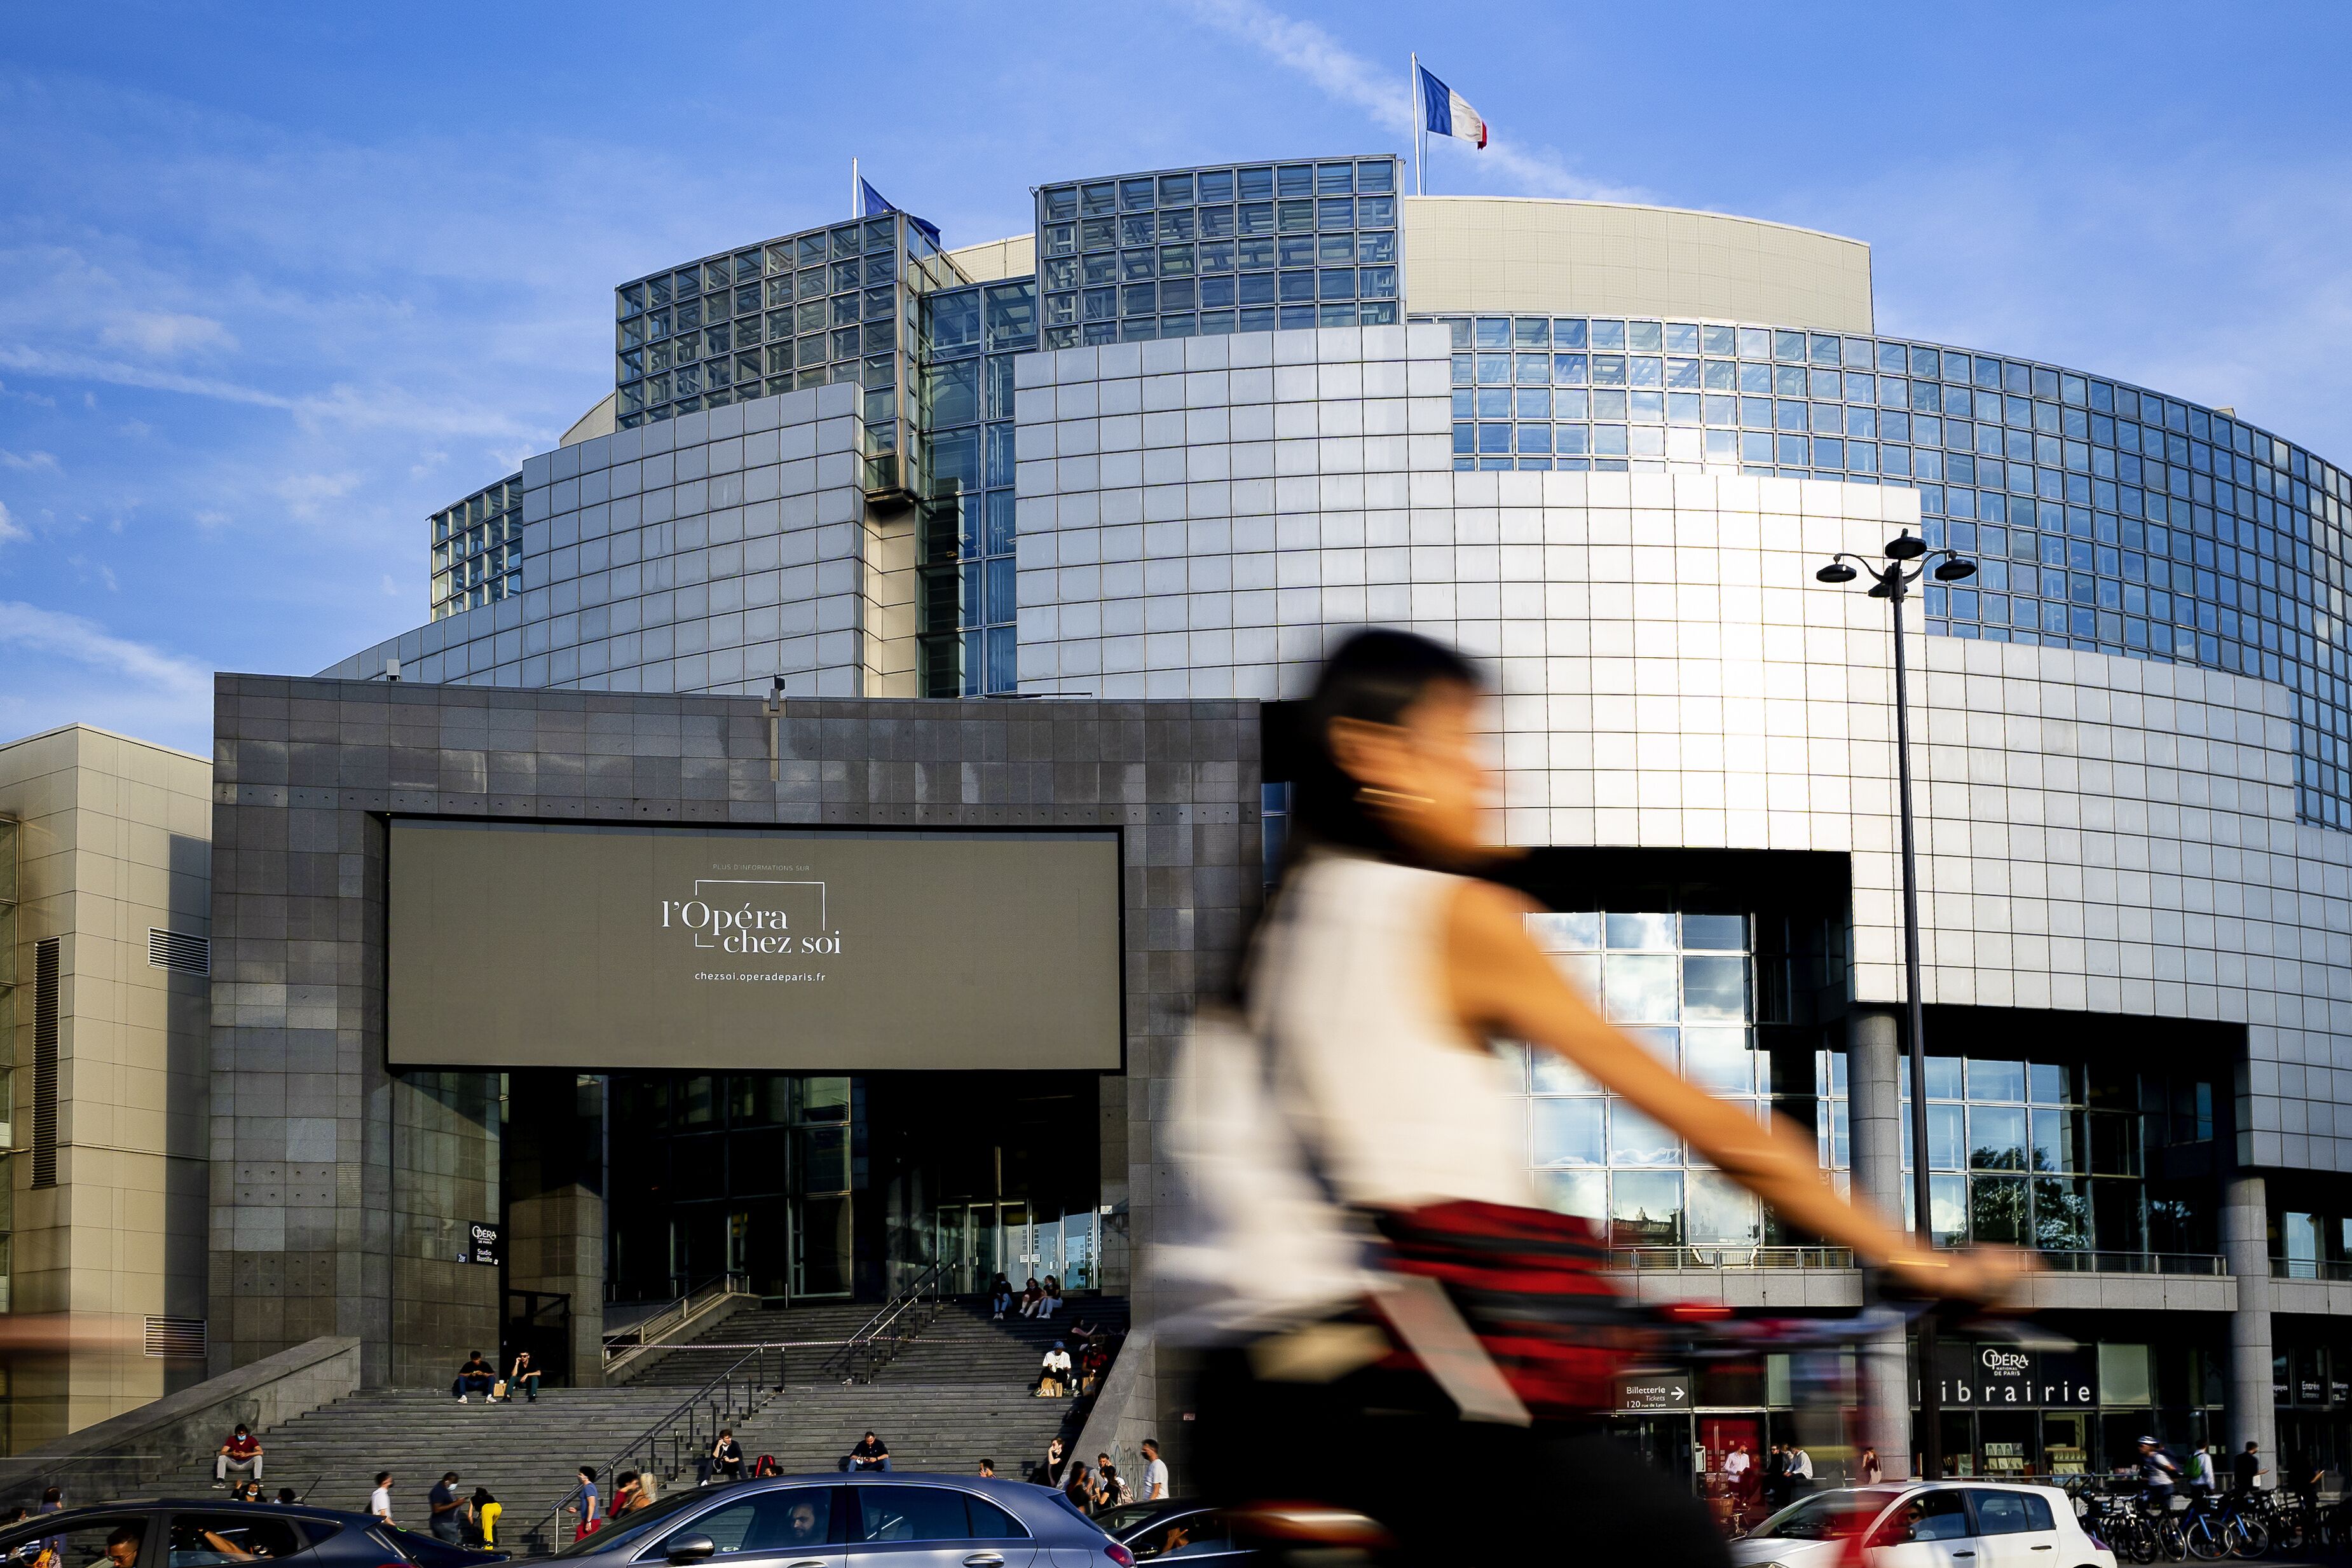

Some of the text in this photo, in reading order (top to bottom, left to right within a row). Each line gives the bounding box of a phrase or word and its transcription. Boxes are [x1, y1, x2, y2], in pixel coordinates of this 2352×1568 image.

[662, 901, 789, 936] l'Opéra
[723, 929, 842, 954] chez soi
[695, 972, 826, 983] chezsoi.operadeparis.fr
[472, 1225, 496, 1240] OPÉRA
[1983, 1349, 2029, 1370] OPÉRA
